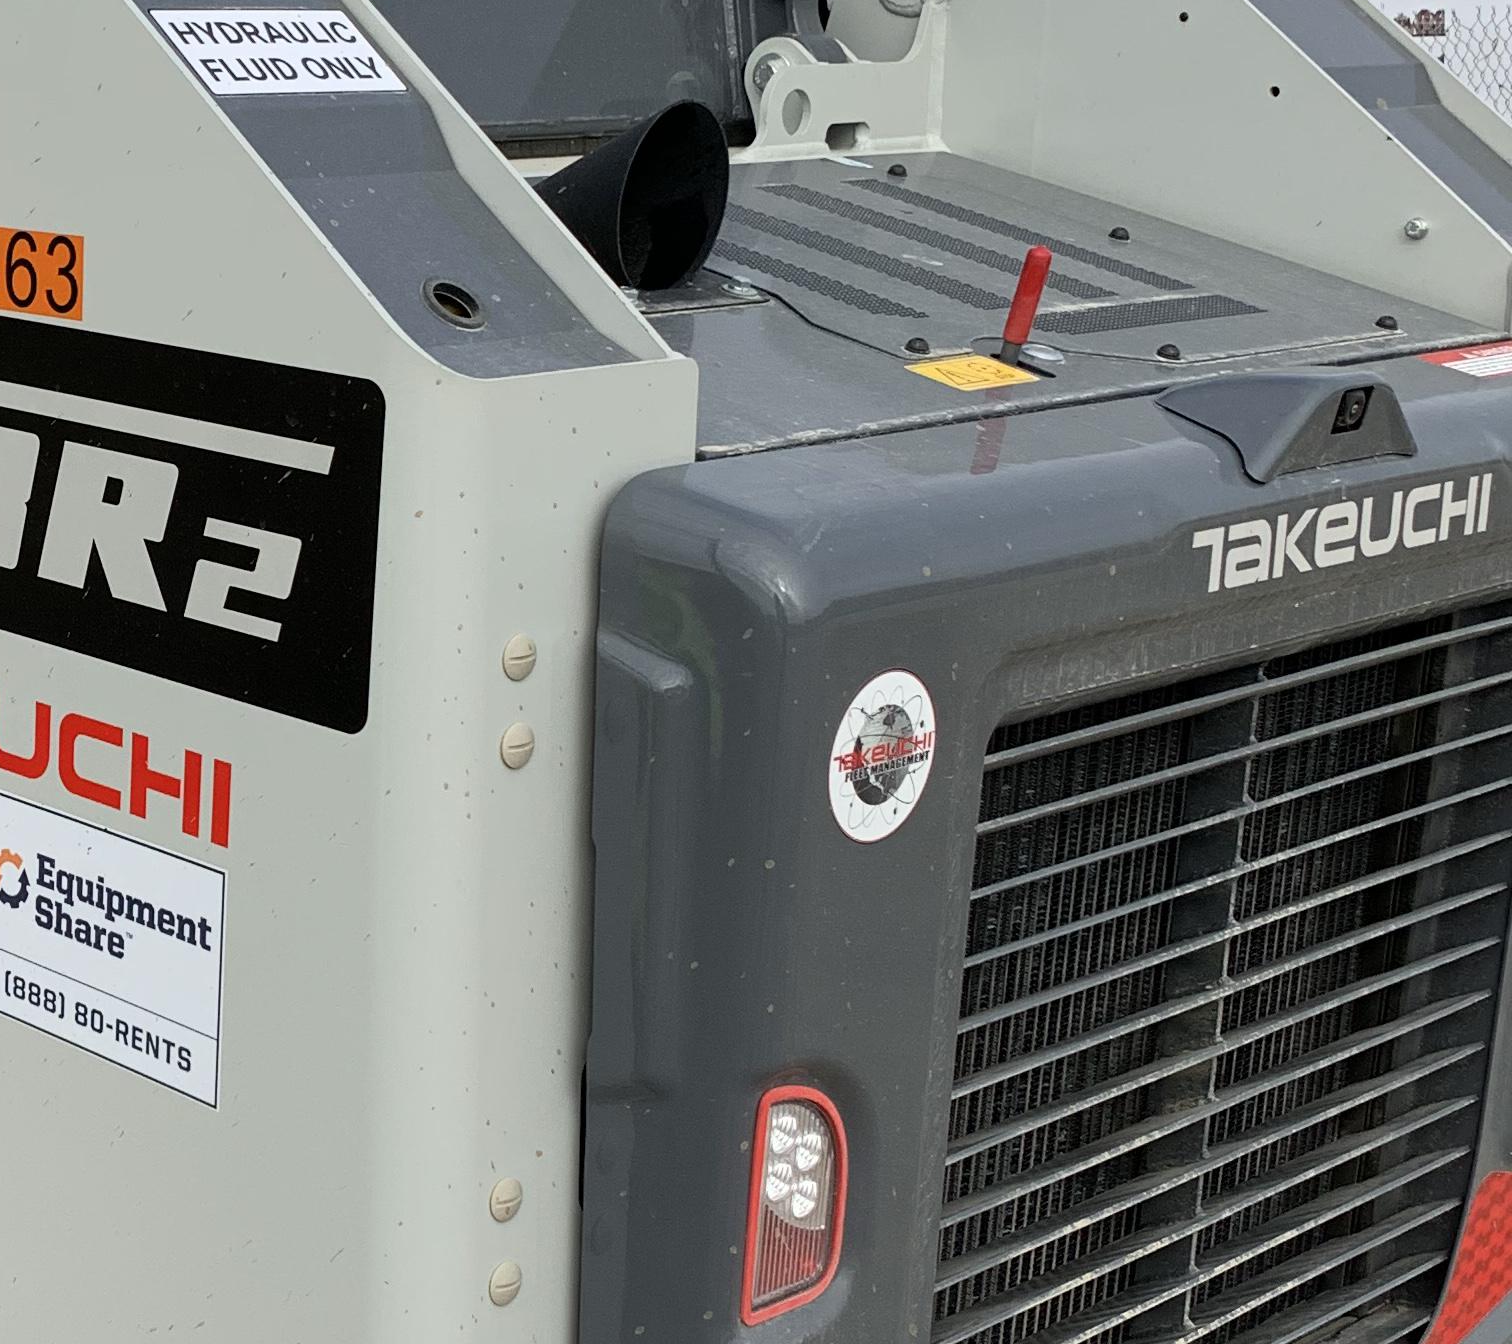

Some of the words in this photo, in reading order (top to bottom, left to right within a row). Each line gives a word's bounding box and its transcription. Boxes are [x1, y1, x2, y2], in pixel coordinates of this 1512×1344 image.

[168, 21, 357, 45] HYDRAULIC
[199, 57, 298, 82] FLUID
[301, 56, 383, 80] ONLY
[870, 750, 929, 774] MANAGEMENT
[35, 852, 212, 952] Equipment
[4, 969, 66, 1020] (888)
[74, 1001, 192, 1074] 80-RENTS
